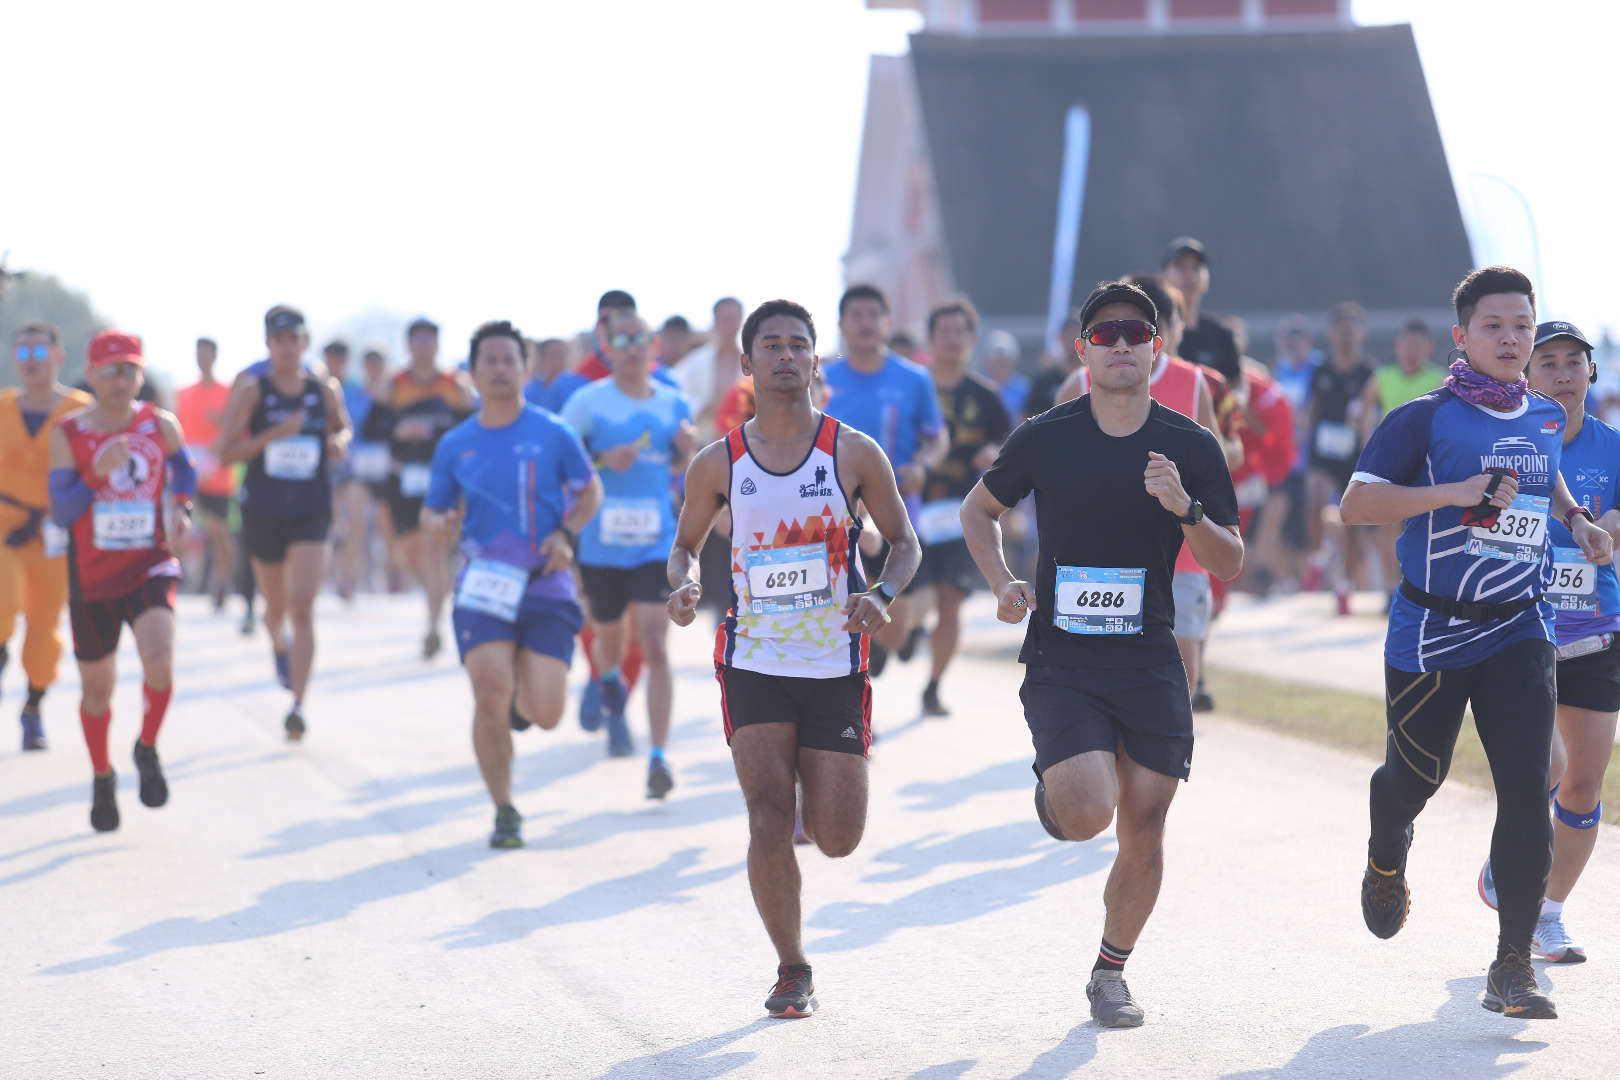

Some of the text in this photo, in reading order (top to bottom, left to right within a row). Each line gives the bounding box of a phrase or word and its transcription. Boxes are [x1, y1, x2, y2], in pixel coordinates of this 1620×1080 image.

[1480, 454, 1549, 473] WORKPOINT
[1575, 474, 1586, 482] SP
[1582, 494, 1590, 510] CR
[1593, 495, 1601, 520] SING
[765, 568, 807, 589] 6291
[1076, 590, 1125, 608] 6286
